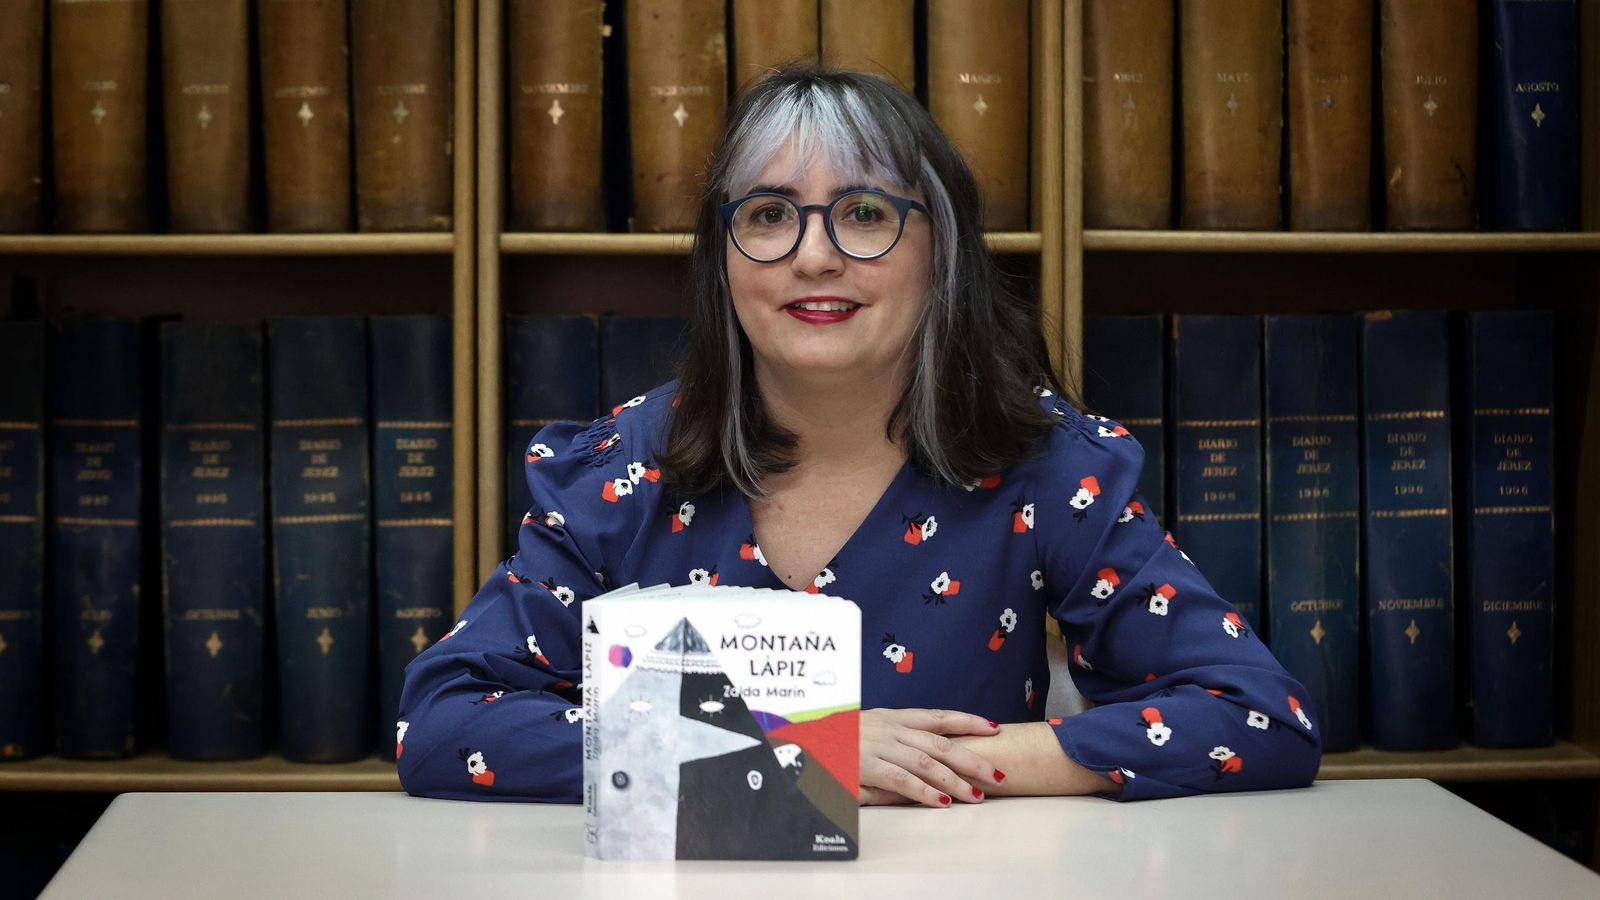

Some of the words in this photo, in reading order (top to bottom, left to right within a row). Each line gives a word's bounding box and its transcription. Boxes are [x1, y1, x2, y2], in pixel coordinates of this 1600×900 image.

[1515, 82, 1560, 93] AGOSTO
[1199, 438, 1238, 449] DIARIO
[1292, 435, 1331, 447] DIARIO
[1387, 432, 1426, 444] DIARIO
[1494, 433, 1533, 444] DIARIO
[1304, 450, 1320, 460] DE
[1400, 447, 1415, 458] DE
[1506, 448, 1521, 458] DE
[1210, 453, 1226, 464] DE
[1296, 463, 1331, 474] JEREZ
[1391, 459, 1425, 471] JEREZ
[1497, 460, 1532, 471] JEREZ
[1202, 466, 1237, 477] JEREZ
[1394, 484, 1424, 496] 1996
[1499, 485, 1529, 496] 1996
[1290, 599, 1344, 612] OCTUBRE
[1378, 598, 1444, 610] NOVIEMBRE
[1483, 600, 1544, 612] DICIEMBRE
[720, 631, 837, 652] MONTAÑA
[749, 655, 806, 677] LÁPIZ
[723, 685, 761, 698] Zaida
[815, 834, 846, 845] Koala
